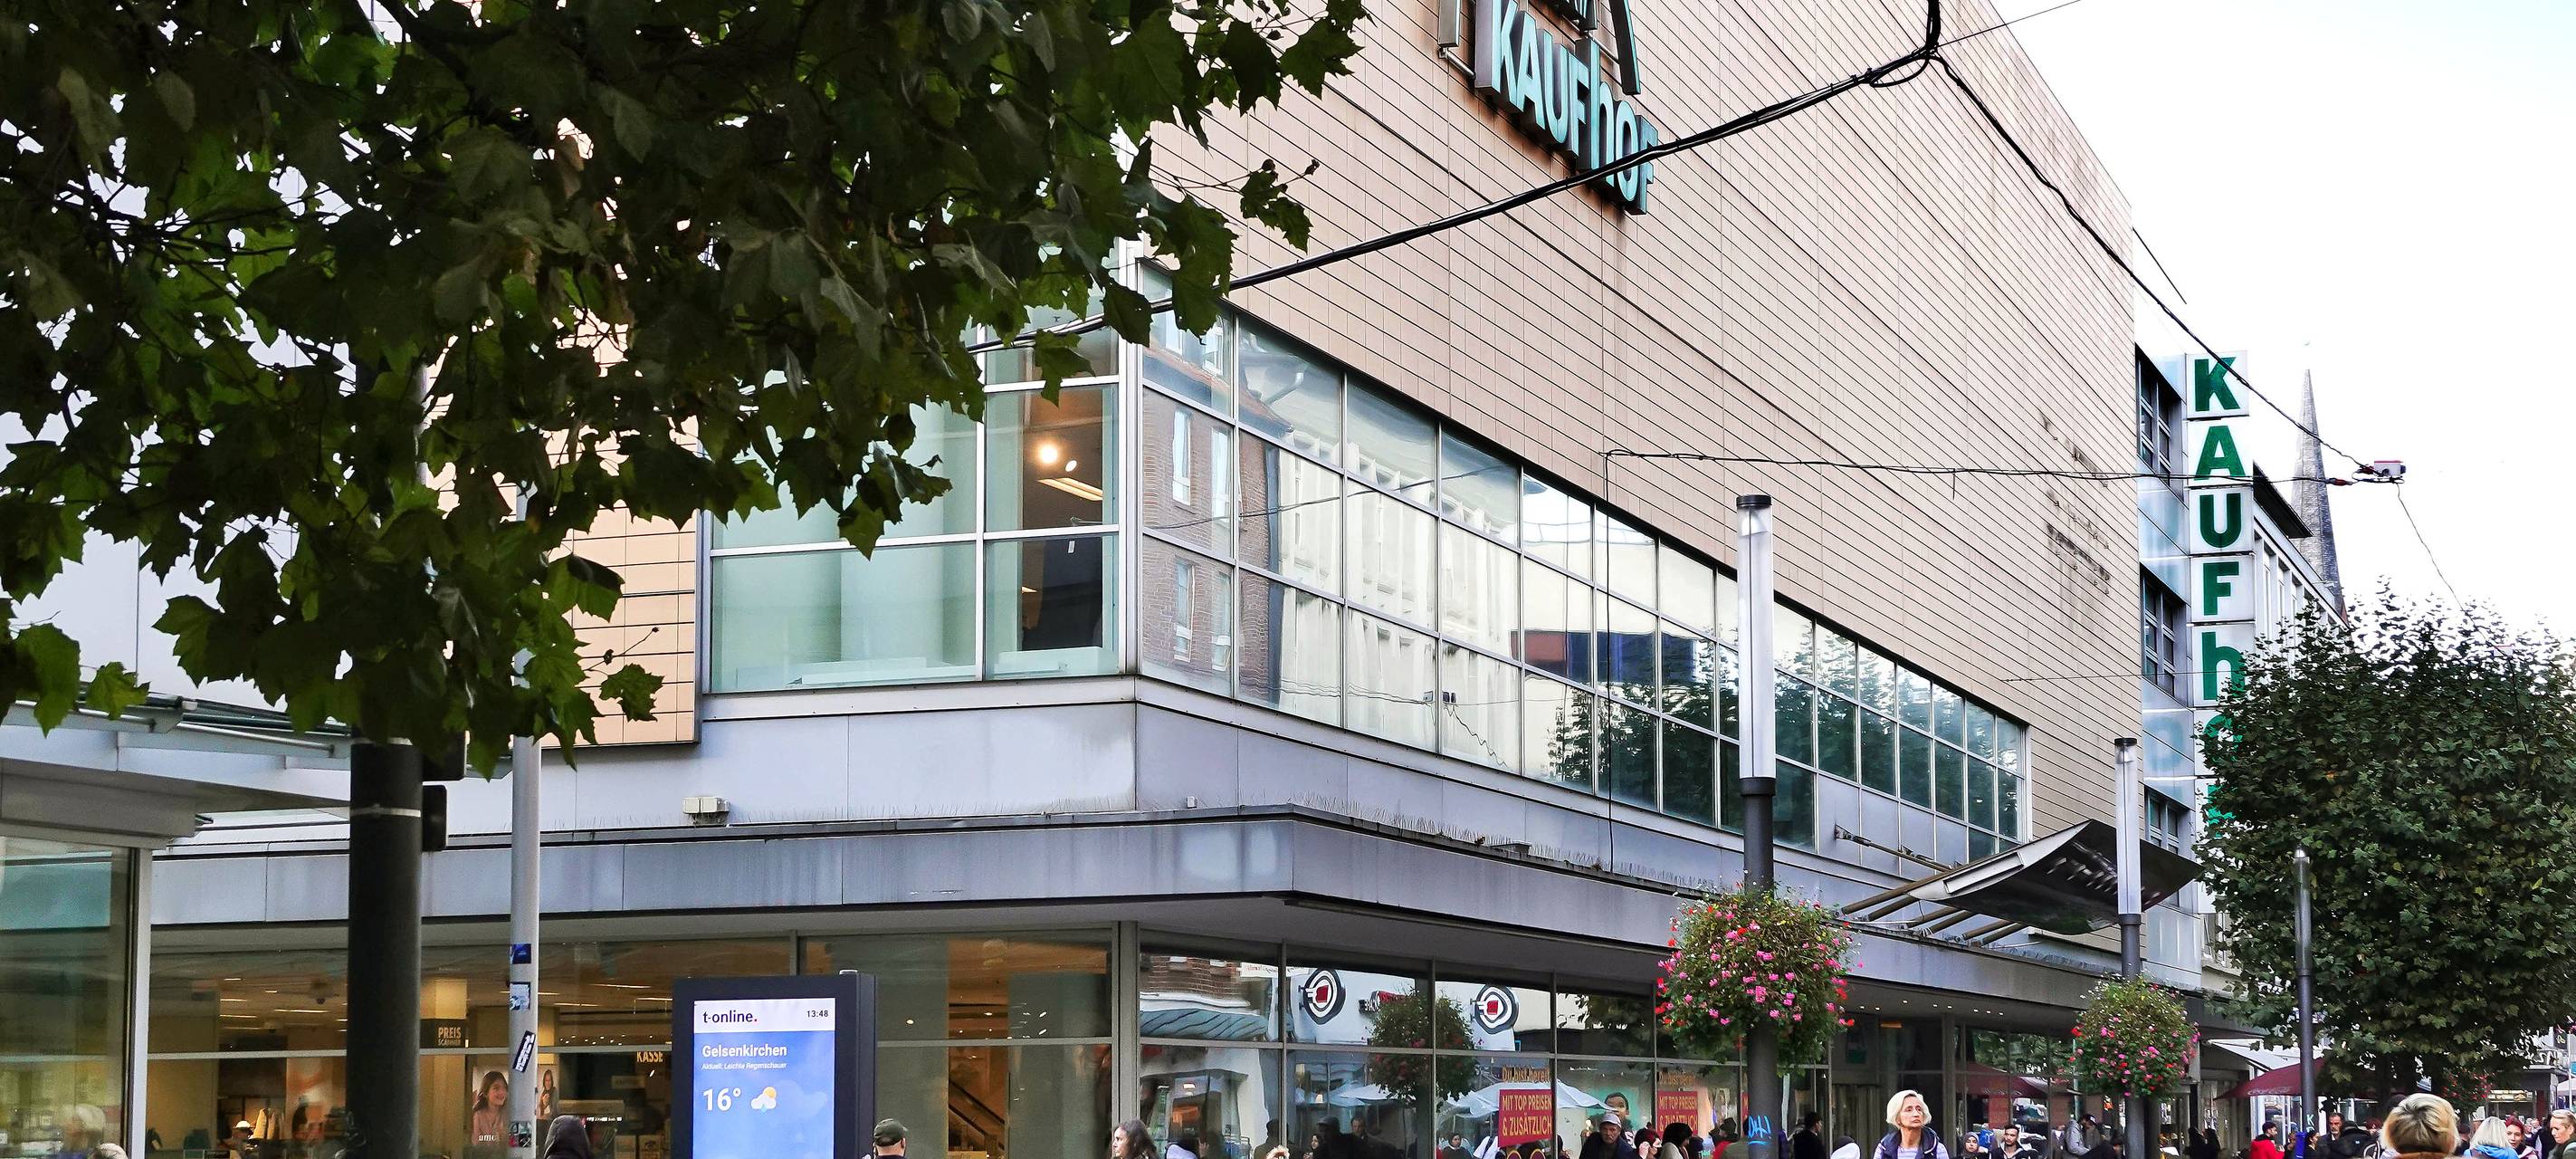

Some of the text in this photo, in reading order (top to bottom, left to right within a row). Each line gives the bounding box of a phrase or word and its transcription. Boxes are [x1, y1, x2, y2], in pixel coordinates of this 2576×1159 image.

[806, 1010, 828, 1018] 13:48
[438, 1027, 461, 1039] PREIS
[636, 1051, 663, 1063] KASSE
[701, 1043, 787, 1058] Gelsenkirchen
[746, 1062, 787, 1070] Regenschauer
[702, 1087, 741, 1111] 16°
[1503, 1095, 1551, 1110] MIT TOP PREISEN
[1503, 1112, 1551, 1135] & ZUSÄTZLICH
